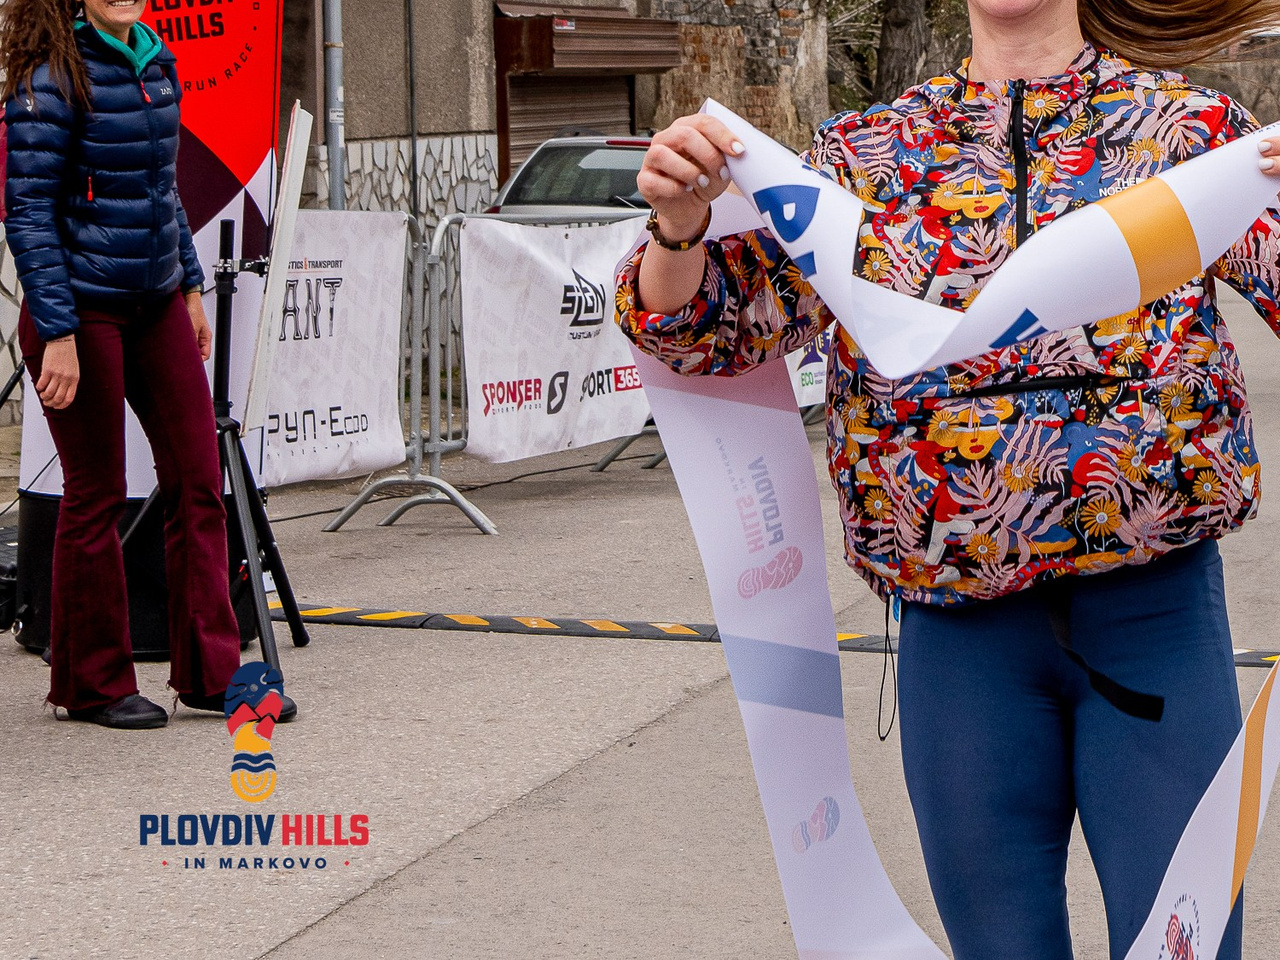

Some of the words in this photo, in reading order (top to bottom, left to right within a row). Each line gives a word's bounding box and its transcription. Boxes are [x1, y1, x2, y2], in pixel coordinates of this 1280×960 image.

[155, 12, 224, 43] HILLS
[224, 43, 253, 79] RACE
[481, 378, 543, 417] SPONSER
